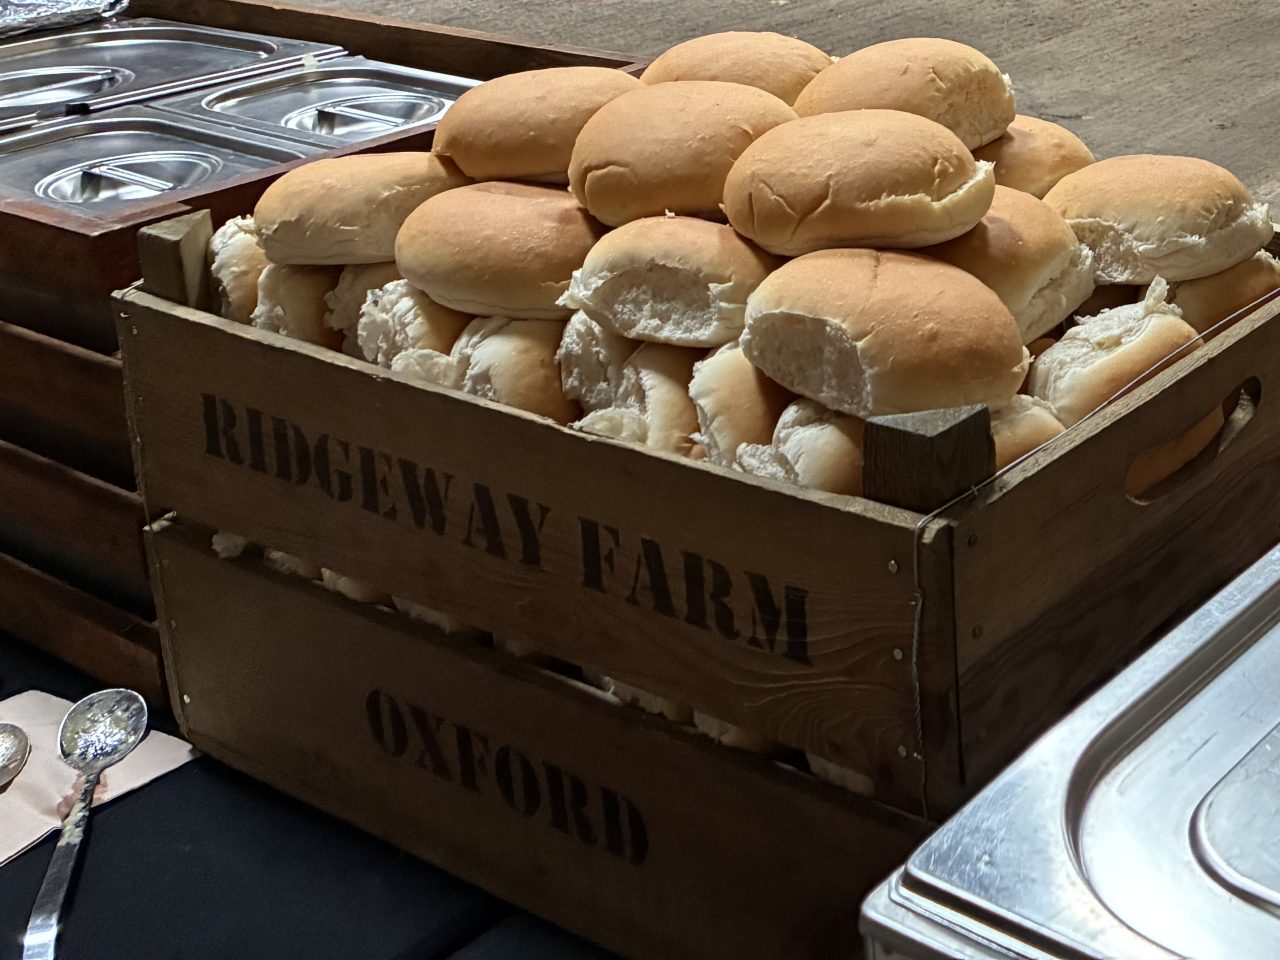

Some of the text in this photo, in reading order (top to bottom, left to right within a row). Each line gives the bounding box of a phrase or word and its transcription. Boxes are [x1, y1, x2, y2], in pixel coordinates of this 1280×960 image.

[203, 394, 813, 665] RIDGEWAY FARM
[366, 690, 650, 863] OXFORD
